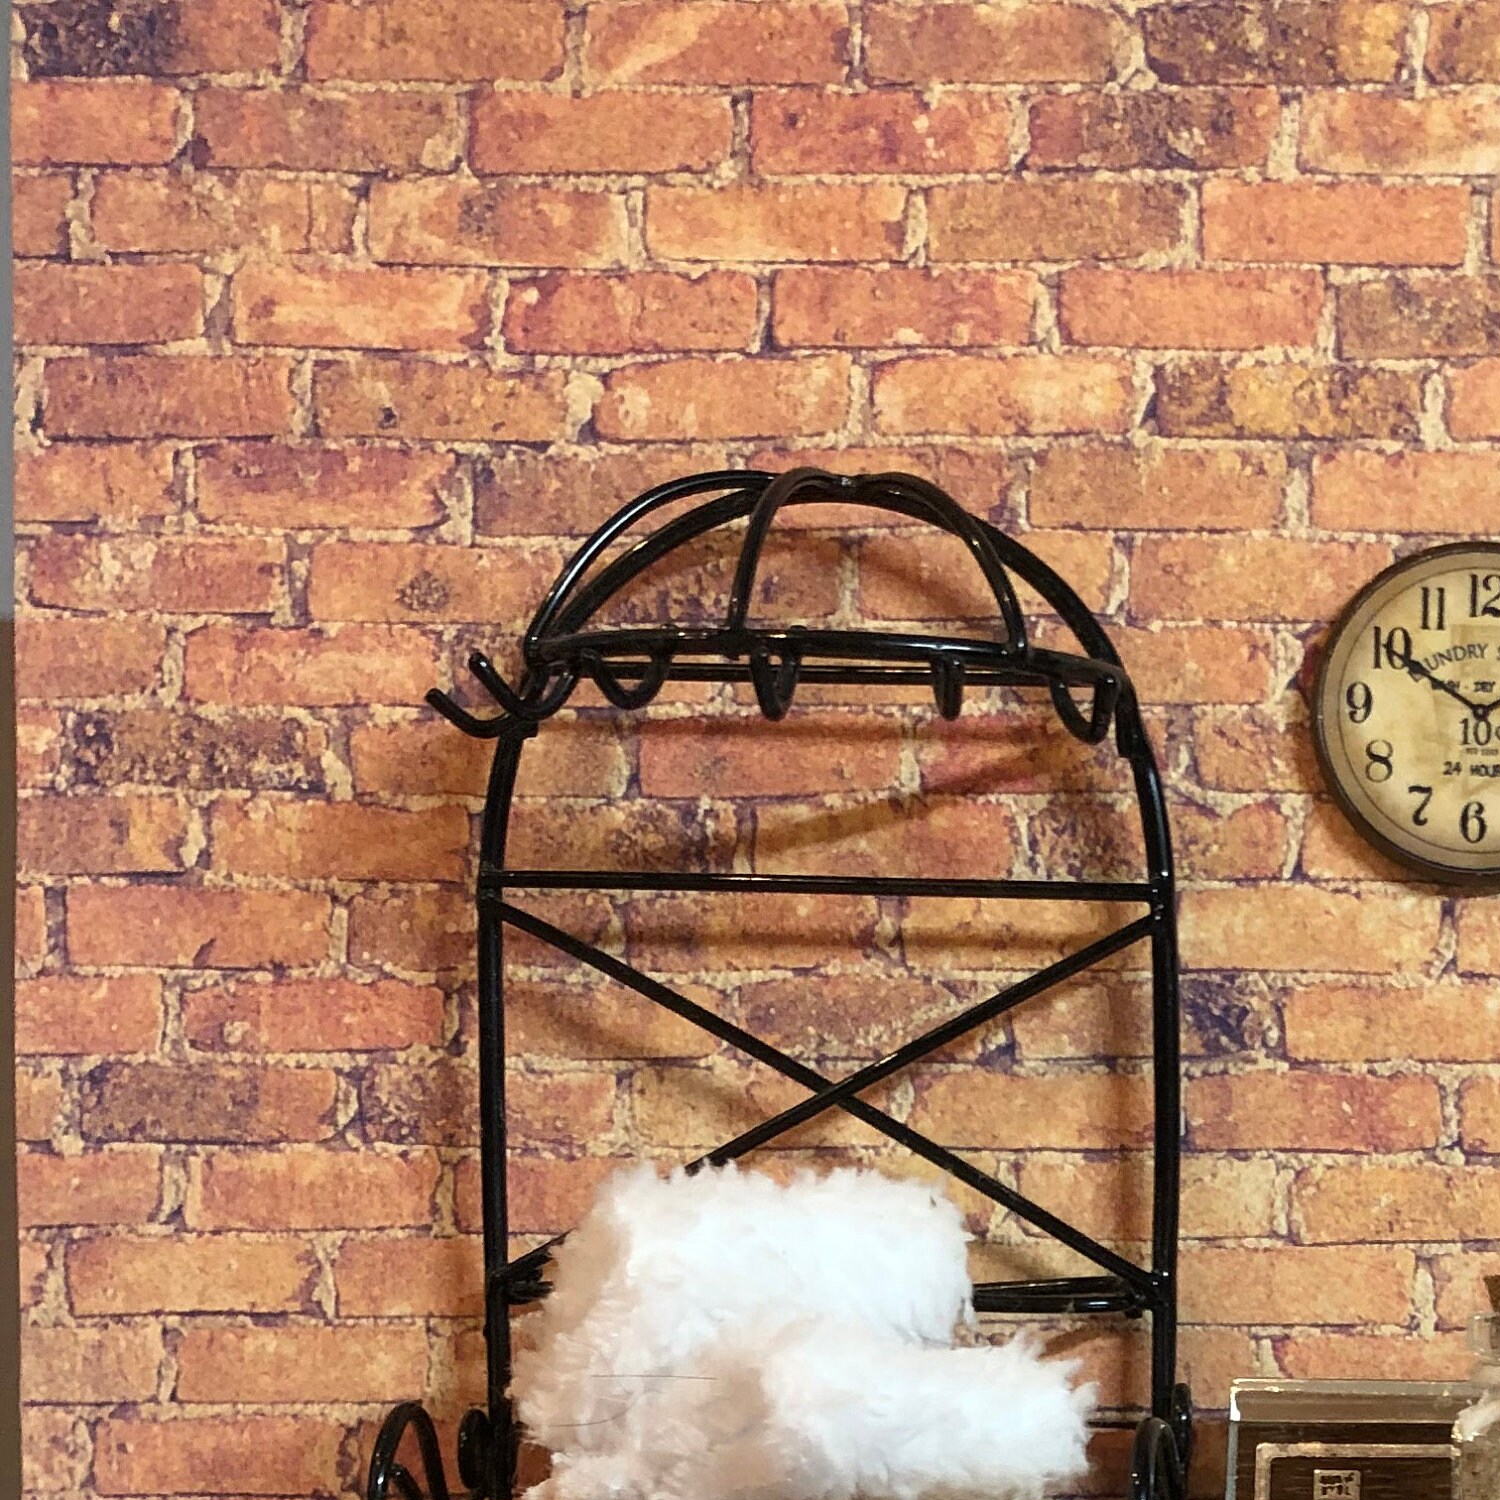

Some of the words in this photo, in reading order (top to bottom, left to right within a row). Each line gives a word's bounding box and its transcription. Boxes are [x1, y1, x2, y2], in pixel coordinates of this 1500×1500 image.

[1420, 586, 1446, 631] 11
[1373, 625, 1413, 670] 10
[1407, 643, 1489, 683] LUNDRY
[1345, 681, 1373, 724] 9
[1364, 739, 1394, 783] 8
[1443, 761, 1462, 776] 24
[1408, 785, 1433, 827] 7
[1460, 801, 1487, 843] 6
